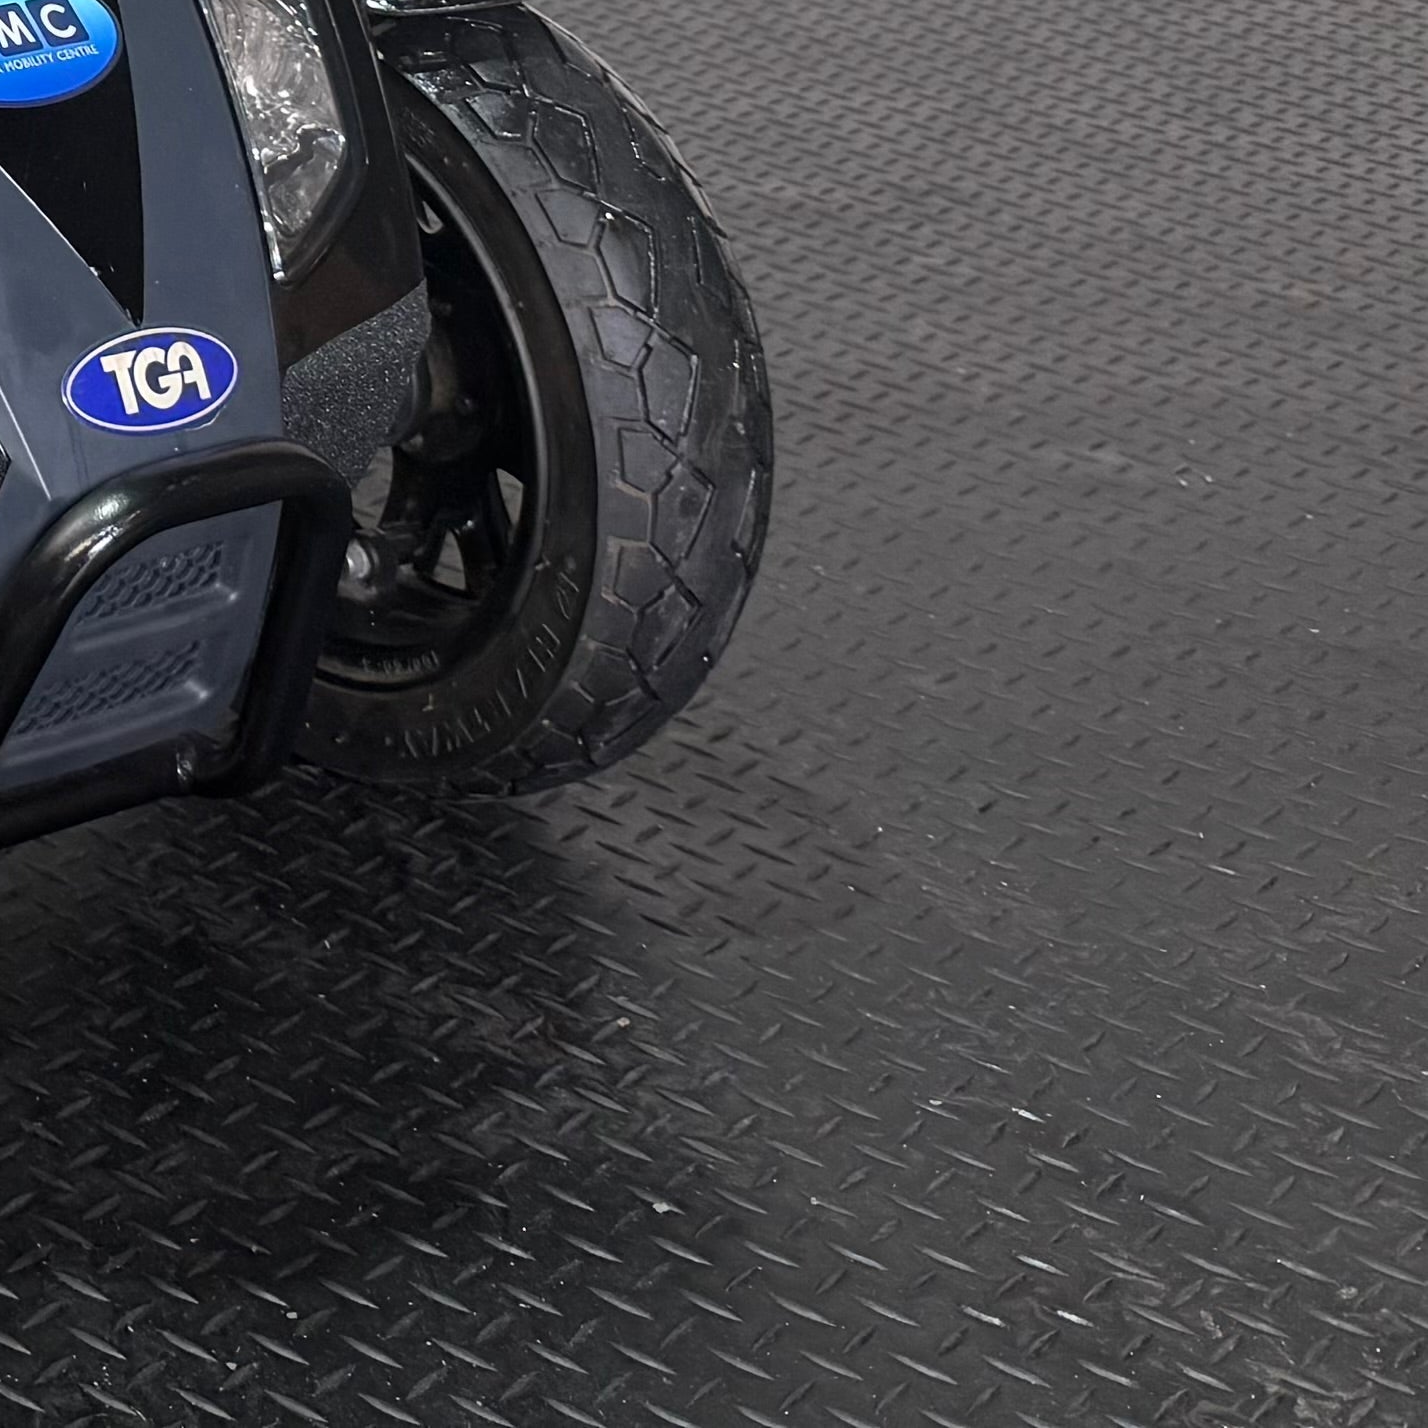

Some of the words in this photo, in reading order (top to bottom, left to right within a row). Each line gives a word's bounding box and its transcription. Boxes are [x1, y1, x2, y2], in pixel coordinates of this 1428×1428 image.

[4, 51, 55, 73] MOBILITY
[56, 43, 100, 62] CENTRE
[99, 340, 213, 415] TGA
